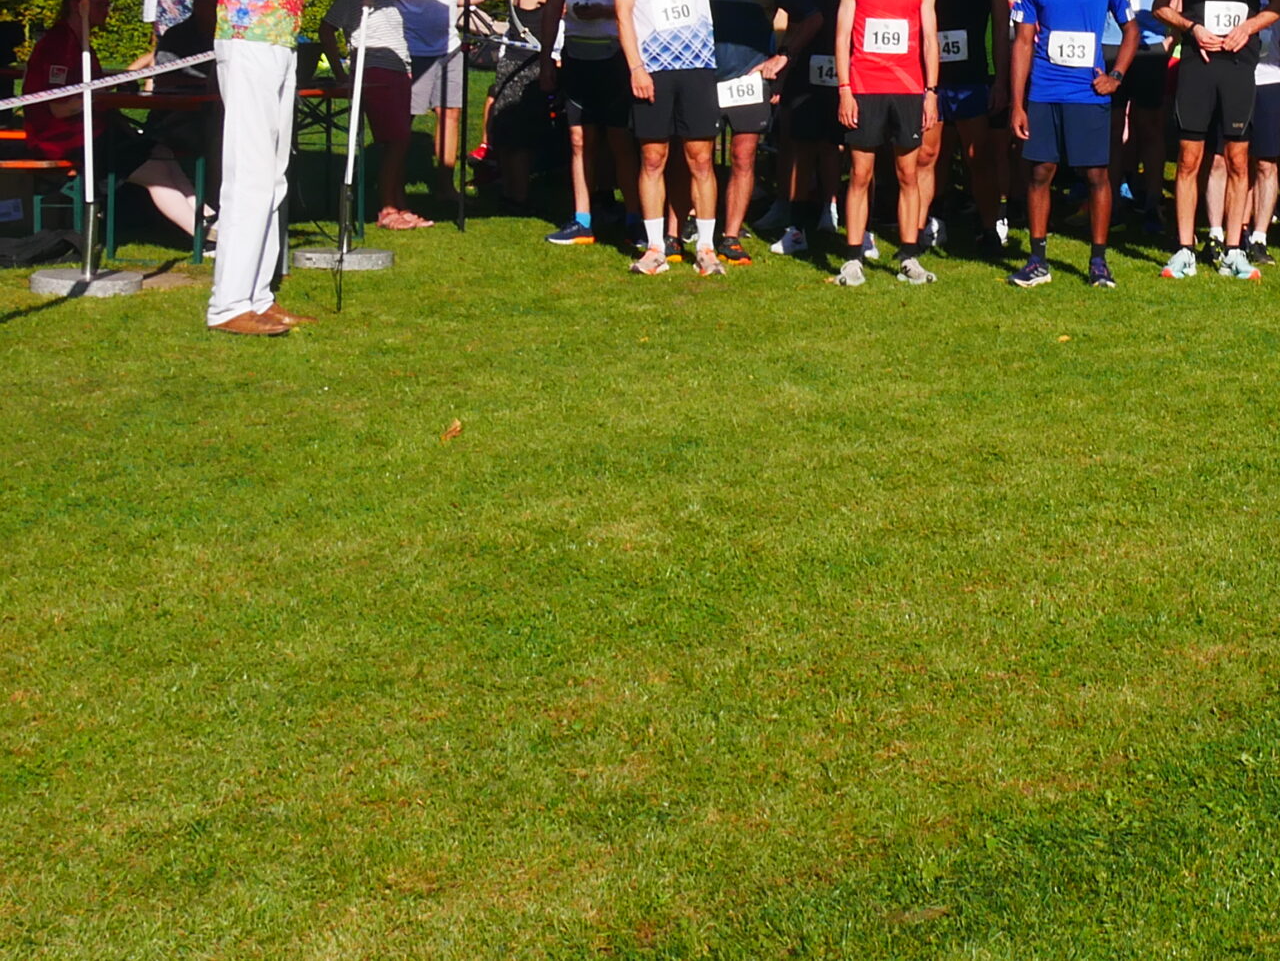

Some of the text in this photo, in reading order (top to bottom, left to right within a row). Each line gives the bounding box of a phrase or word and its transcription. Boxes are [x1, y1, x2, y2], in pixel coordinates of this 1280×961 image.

[662, 4, 690, 21] 150
[1214, 14, 1241, 27] 130
[872, 31, 901, 46] 169
[940, 41, 960, 55] 45
[1057, 44, 1086, 59] 133
[816, 64, 838, 80] 14
[726, 83, 755, 100] 168
